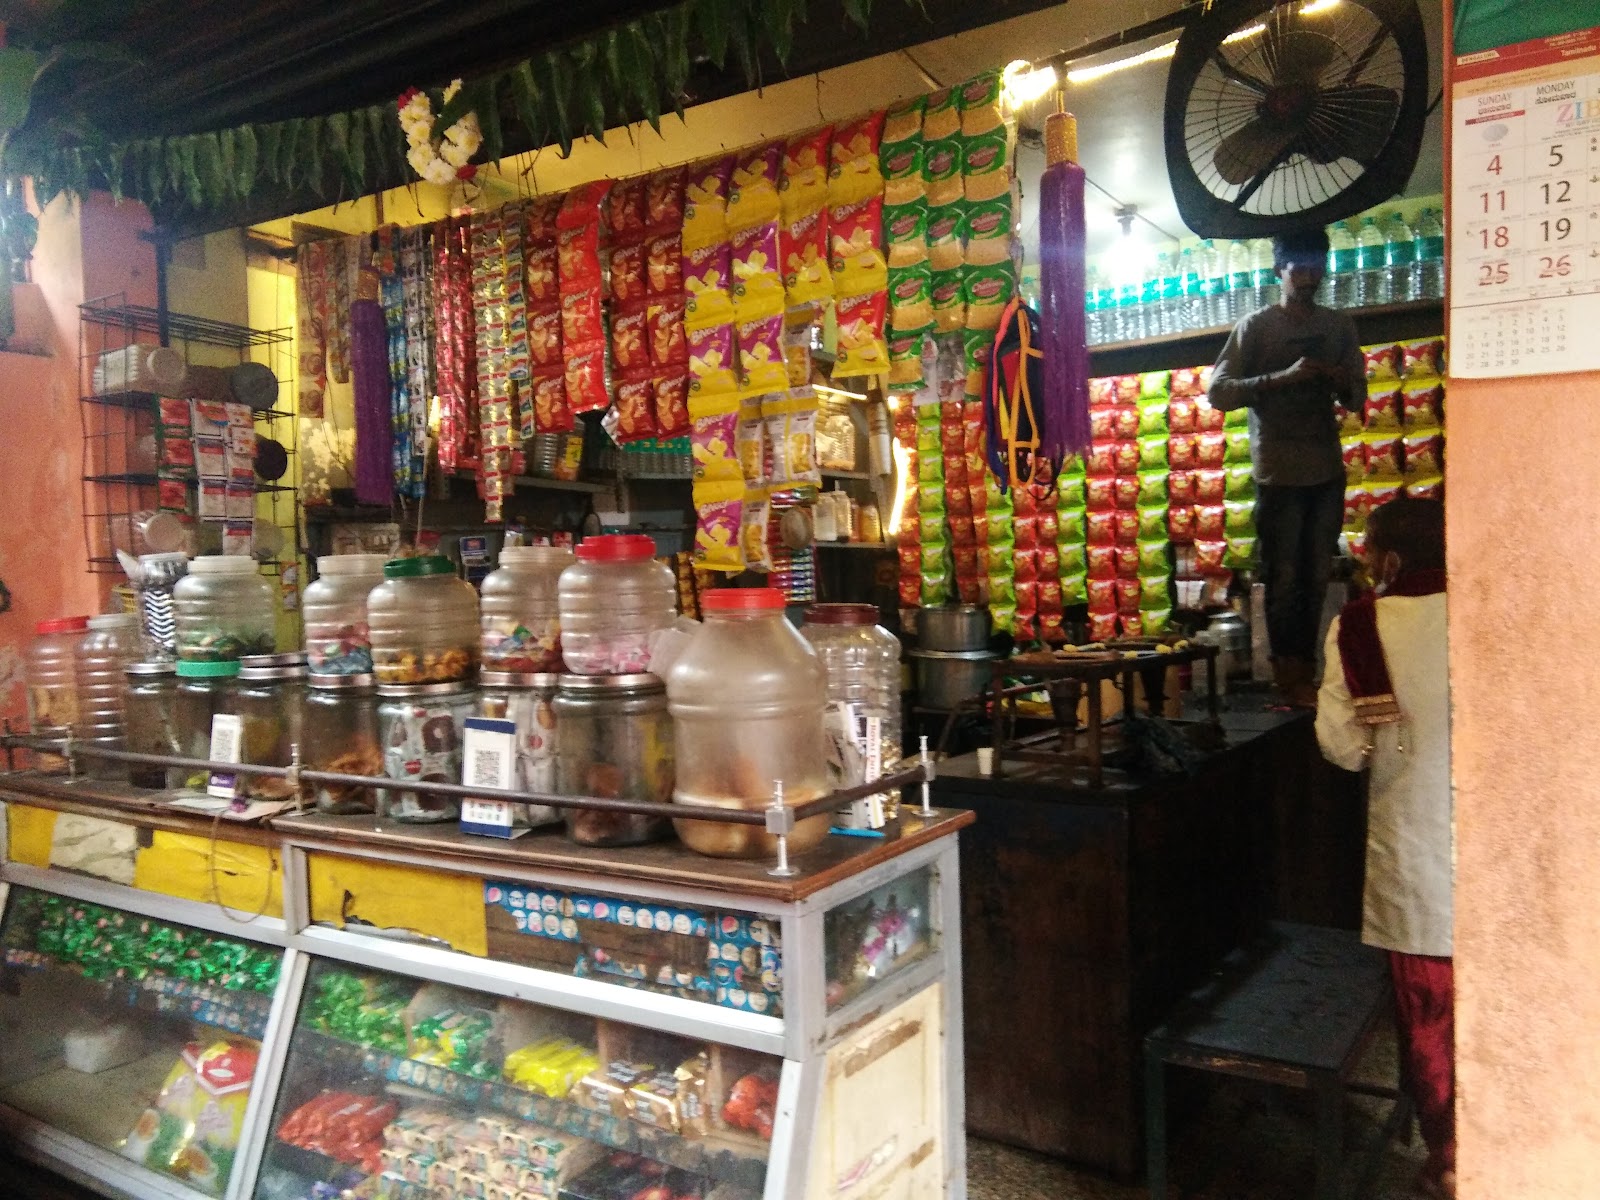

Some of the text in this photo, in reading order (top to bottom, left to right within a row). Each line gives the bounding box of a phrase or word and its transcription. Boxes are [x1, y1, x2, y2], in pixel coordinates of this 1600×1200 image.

[1478, 92, 1513, 107] SUNDAY
[1536, 80, 1576, 95] MONDAY
[1486, 144, 1563, 175] 4 5
[1480, 180, 1571, 213] 11 12
[1479, 218, 1571, 249] 18 19
[1479, 254, 1571, 286] 25 26
